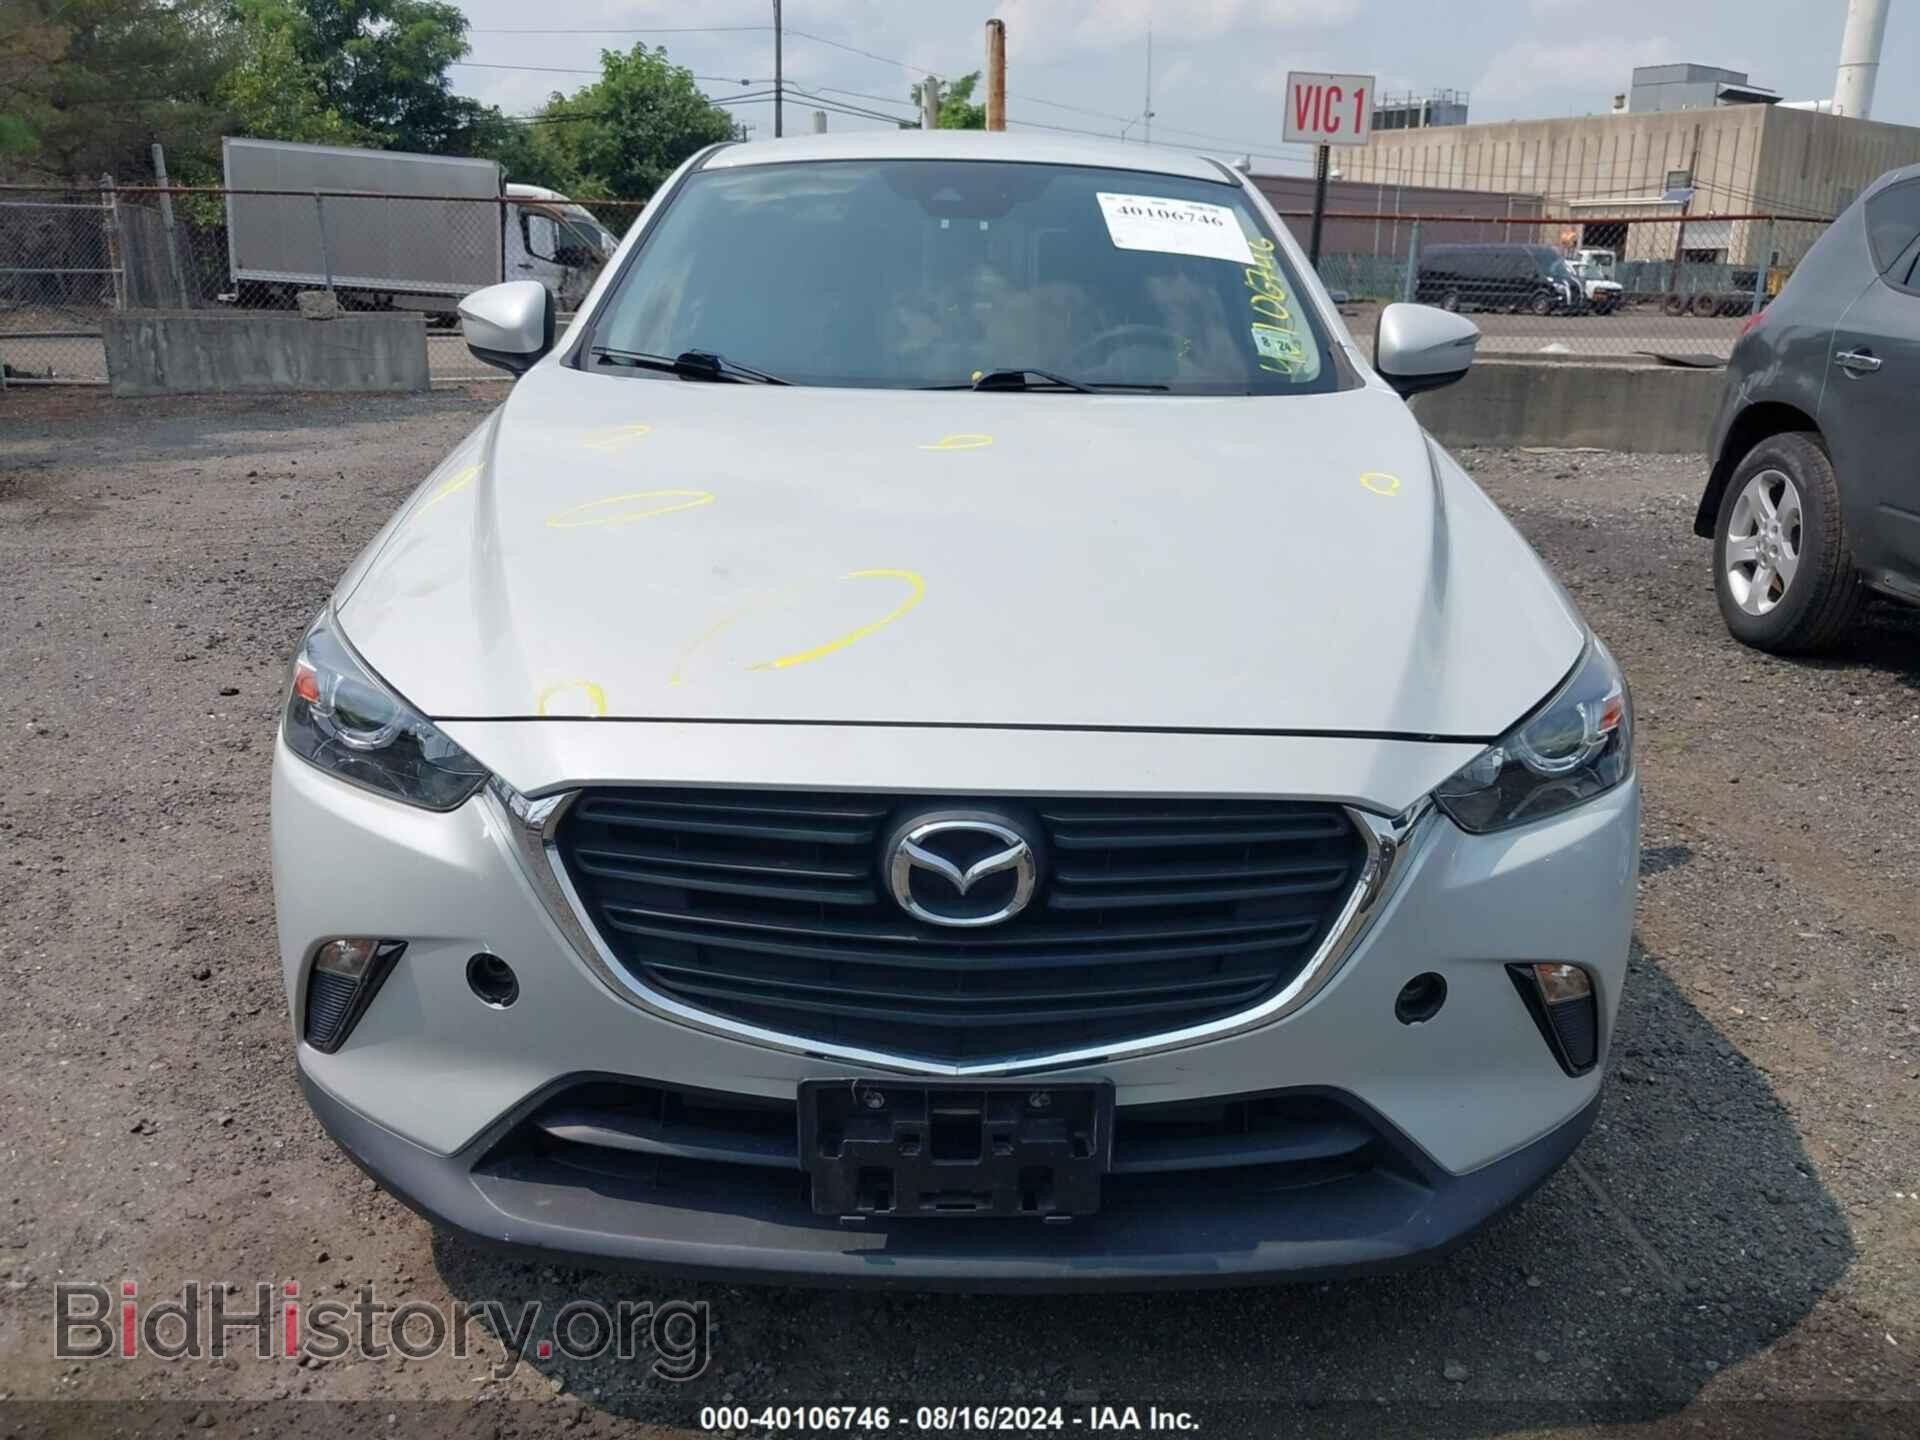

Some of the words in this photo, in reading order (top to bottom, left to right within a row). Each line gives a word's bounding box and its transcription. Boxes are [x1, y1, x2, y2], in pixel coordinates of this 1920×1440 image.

[1295, 84, 1343, 133] VIC
[1353, 87, 1365, 134] 1
[1116, 205, 1224, 227] 40106746
